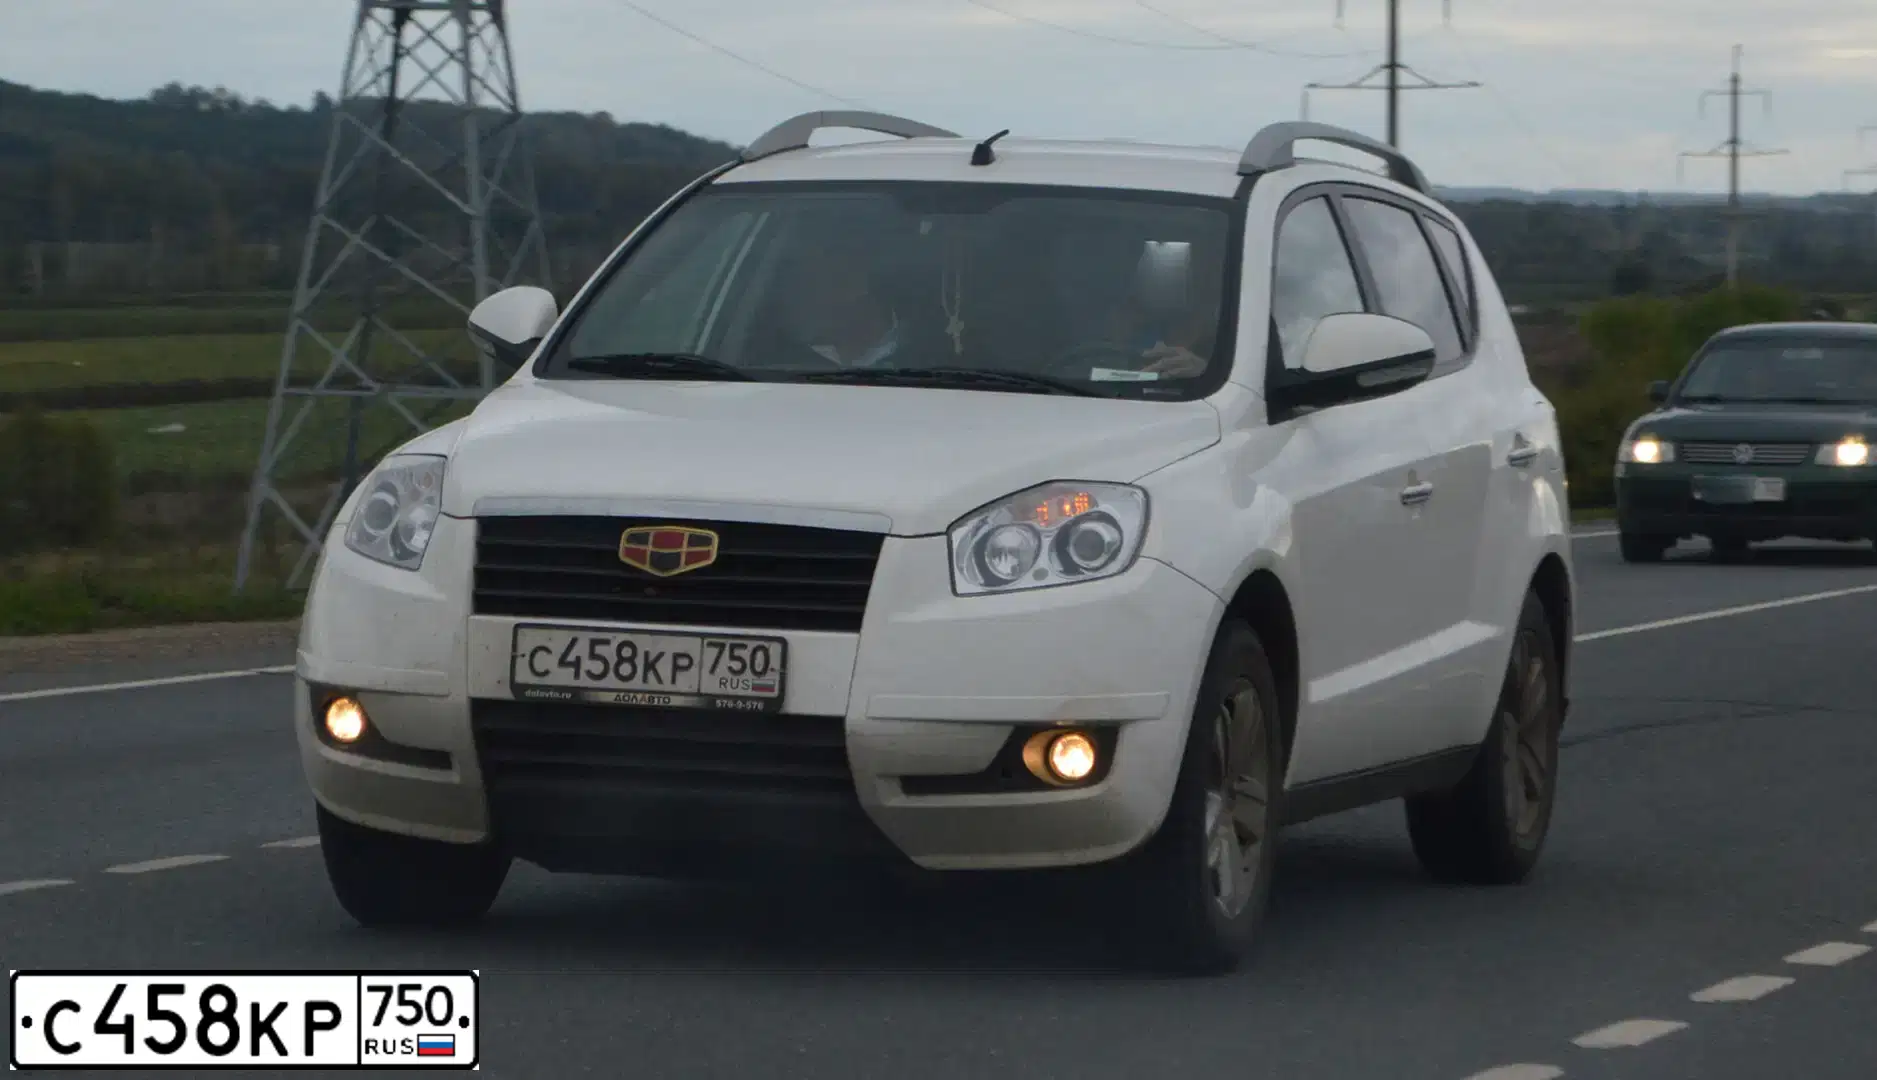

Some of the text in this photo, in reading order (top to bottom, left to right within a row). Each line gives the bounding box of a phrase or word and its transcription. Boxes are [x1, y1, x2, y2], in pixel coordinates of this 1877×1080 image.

[528, 637, 770, 685] С458КР 750
[719, 677, 750, 691] RUS
[525, 689, 572, 700] dolavto.ru
[614, 693, 671, 705] ДОЛАВТО
